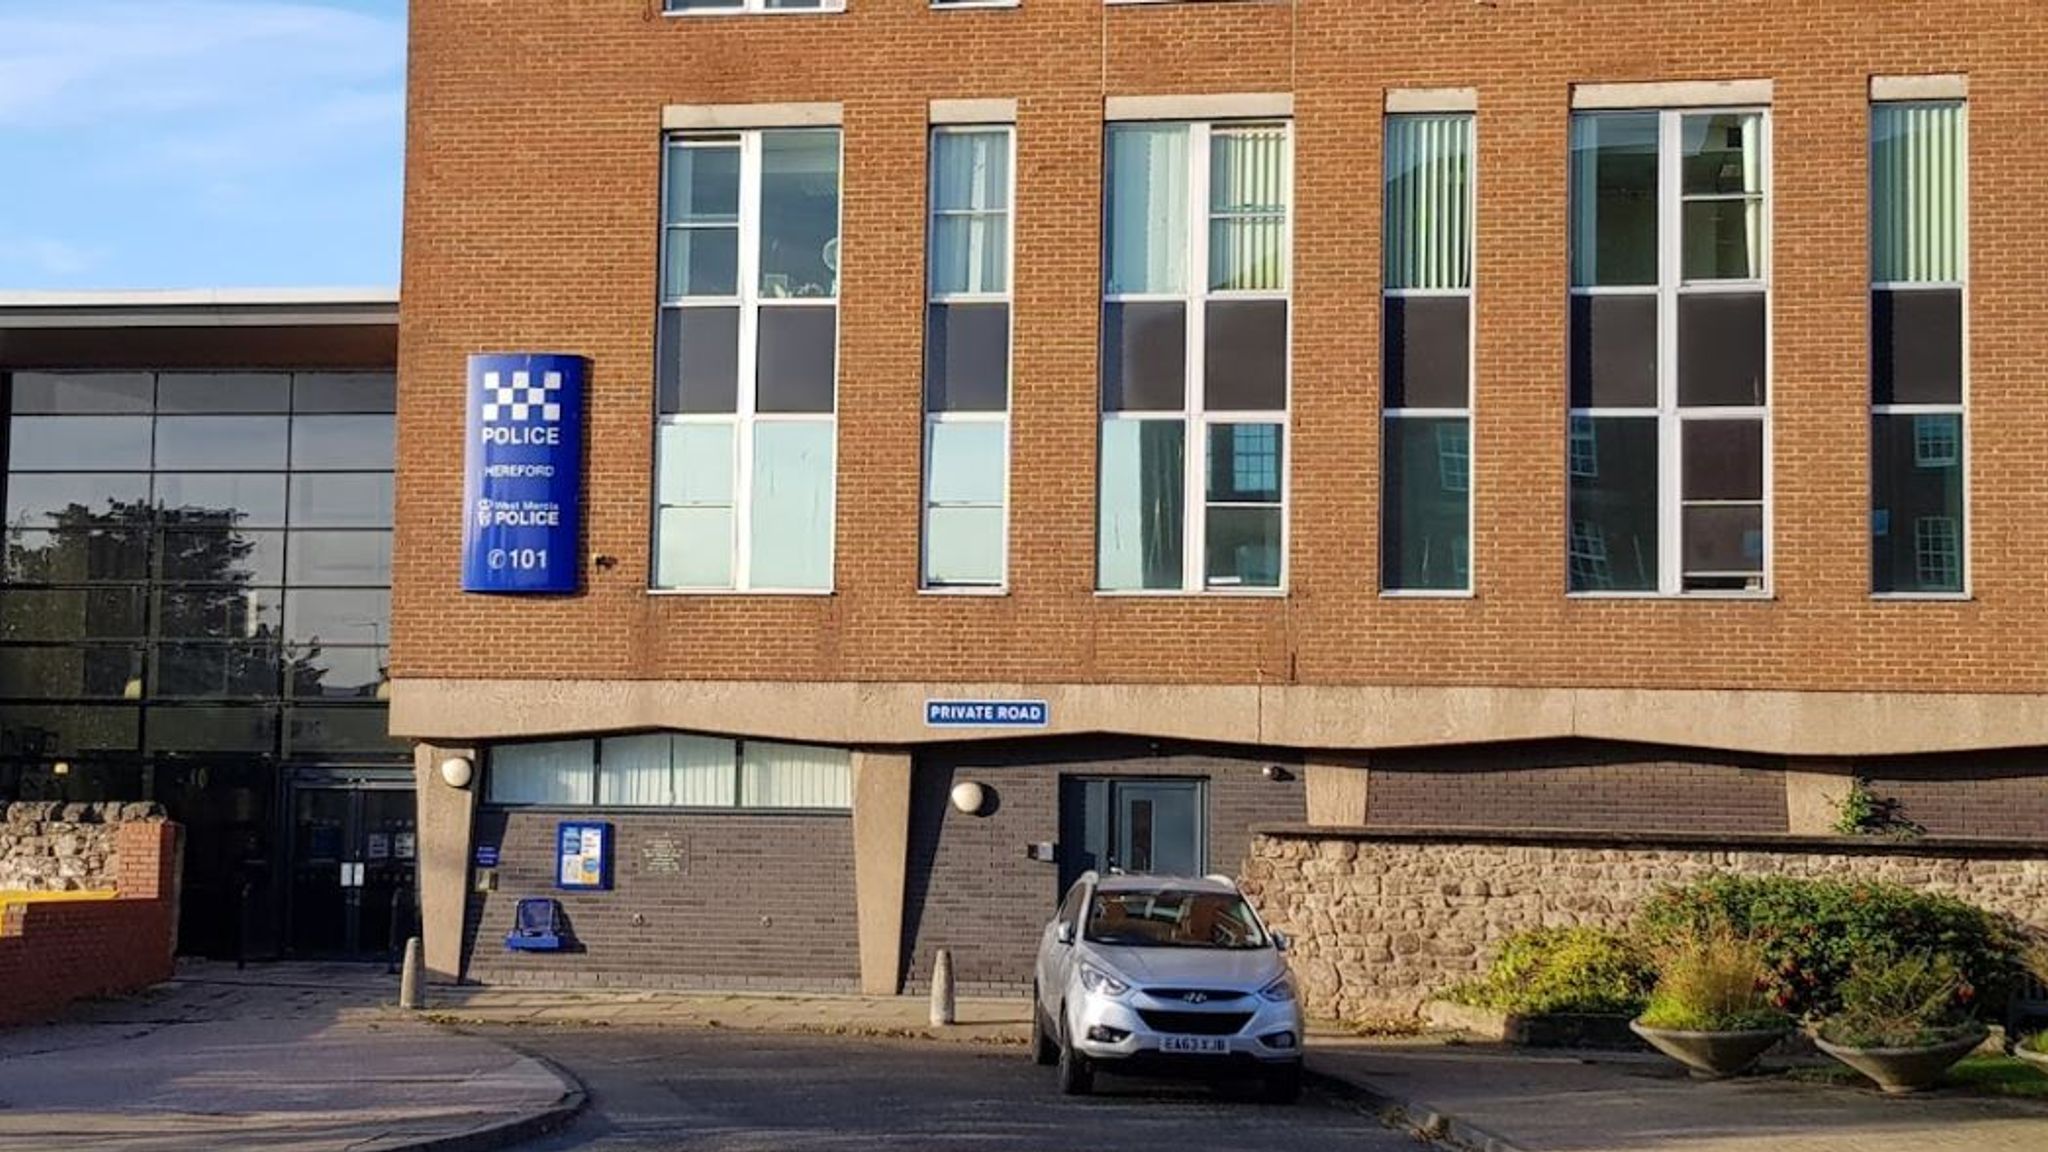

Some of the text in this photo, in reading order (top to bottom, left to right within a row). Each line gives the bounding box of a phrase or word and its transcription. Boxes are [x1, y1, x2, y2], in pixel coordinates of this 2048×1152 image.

[481, 426, 560, 445] POLICE
[484, 464, 555, 478] HEREFORD
[495, 511, 560, 526] POLICE
[509, 549, 547, 568] 101
[930, 705, 1042, 720] PRIVATE ROAD
